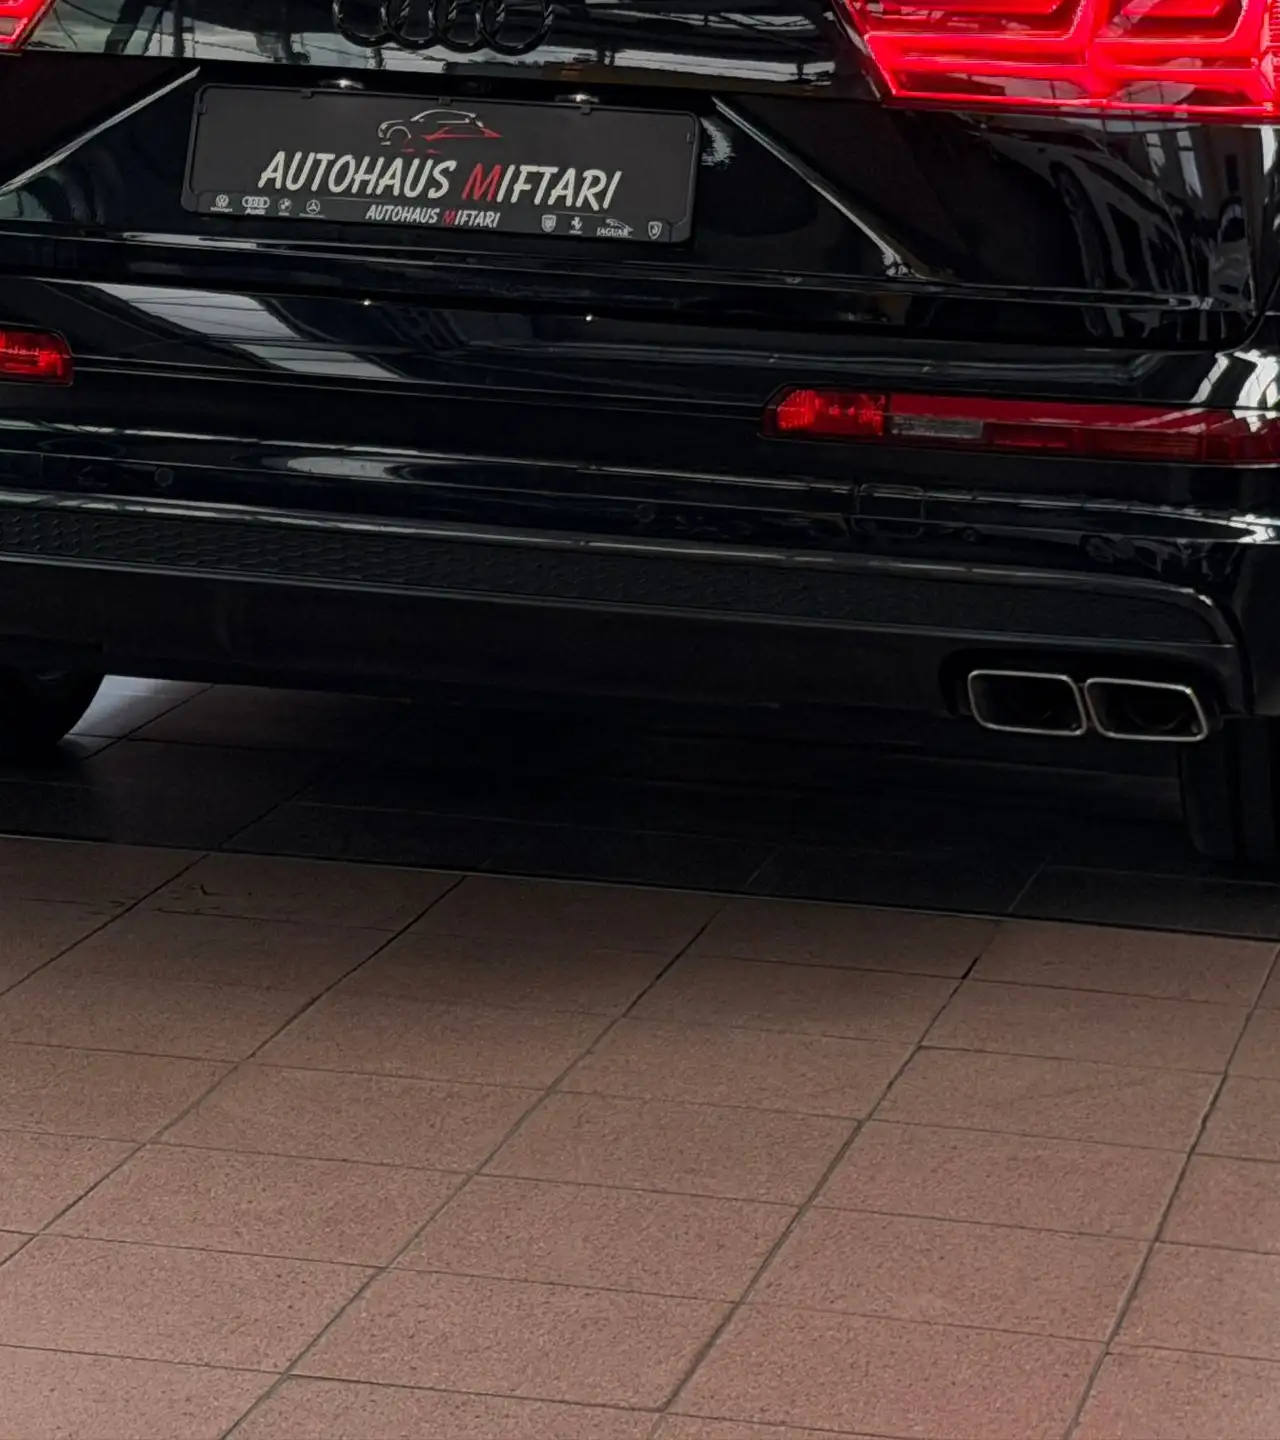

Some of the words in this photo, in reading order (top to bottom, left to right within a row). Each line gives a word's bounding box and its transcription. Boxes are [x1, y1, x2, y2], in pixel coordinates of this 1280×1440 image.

[258, 151, 458, 198] AUTOHAUS
[462, 164, 623, 211] MIFTARI
[365, 203, 441, 224] AUTOHAUS
[442, 207, 501, 228] MIFTARI
